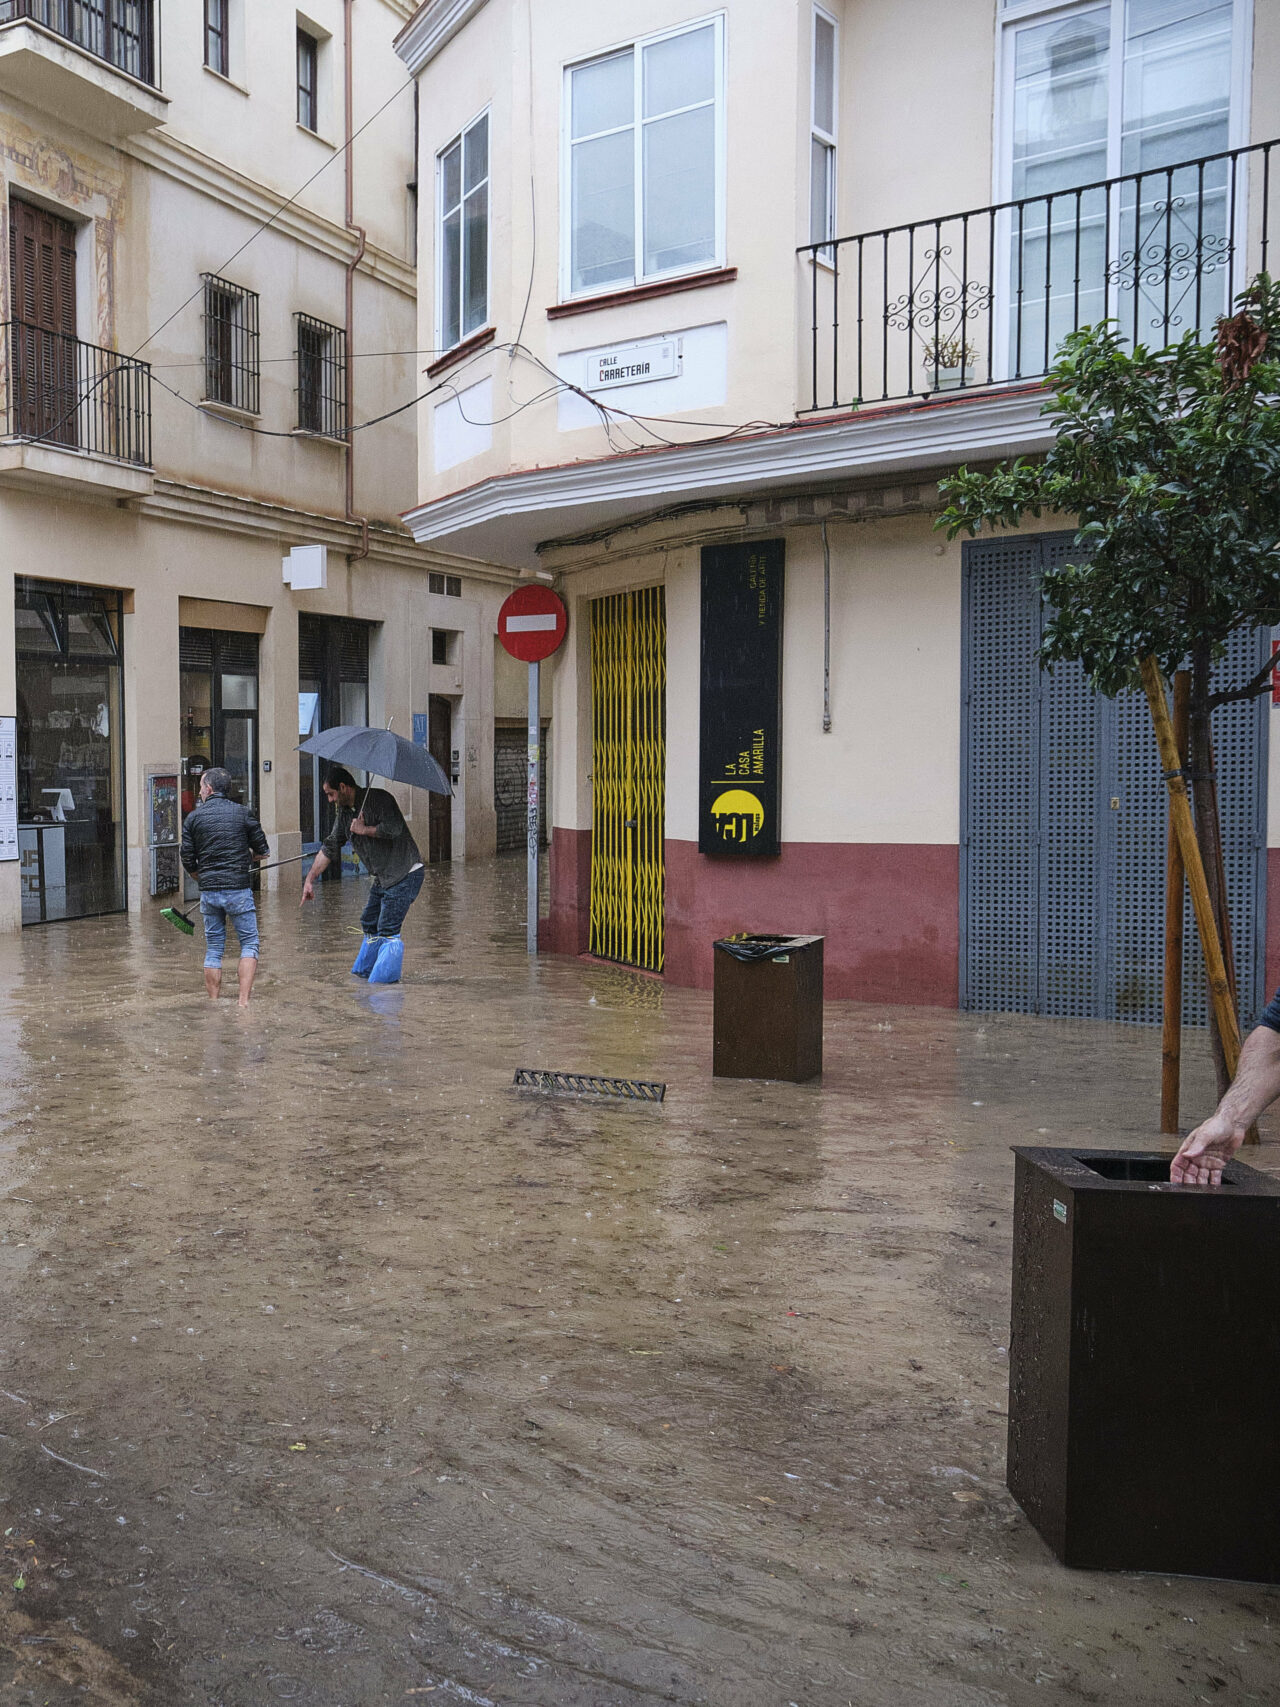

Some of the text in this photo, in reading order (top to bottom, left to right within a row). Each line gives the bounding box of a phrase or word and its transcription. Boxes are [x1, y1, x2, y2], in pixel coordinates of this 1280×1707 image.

[600, 356, 618, 367] CALLE
[600, 362, 650, 381] CARRETERÍA
[753, 728, 765, 775] AMARILLA
[724, 763, 737, 776] LA
[738, 750, 750, 775] CASA
